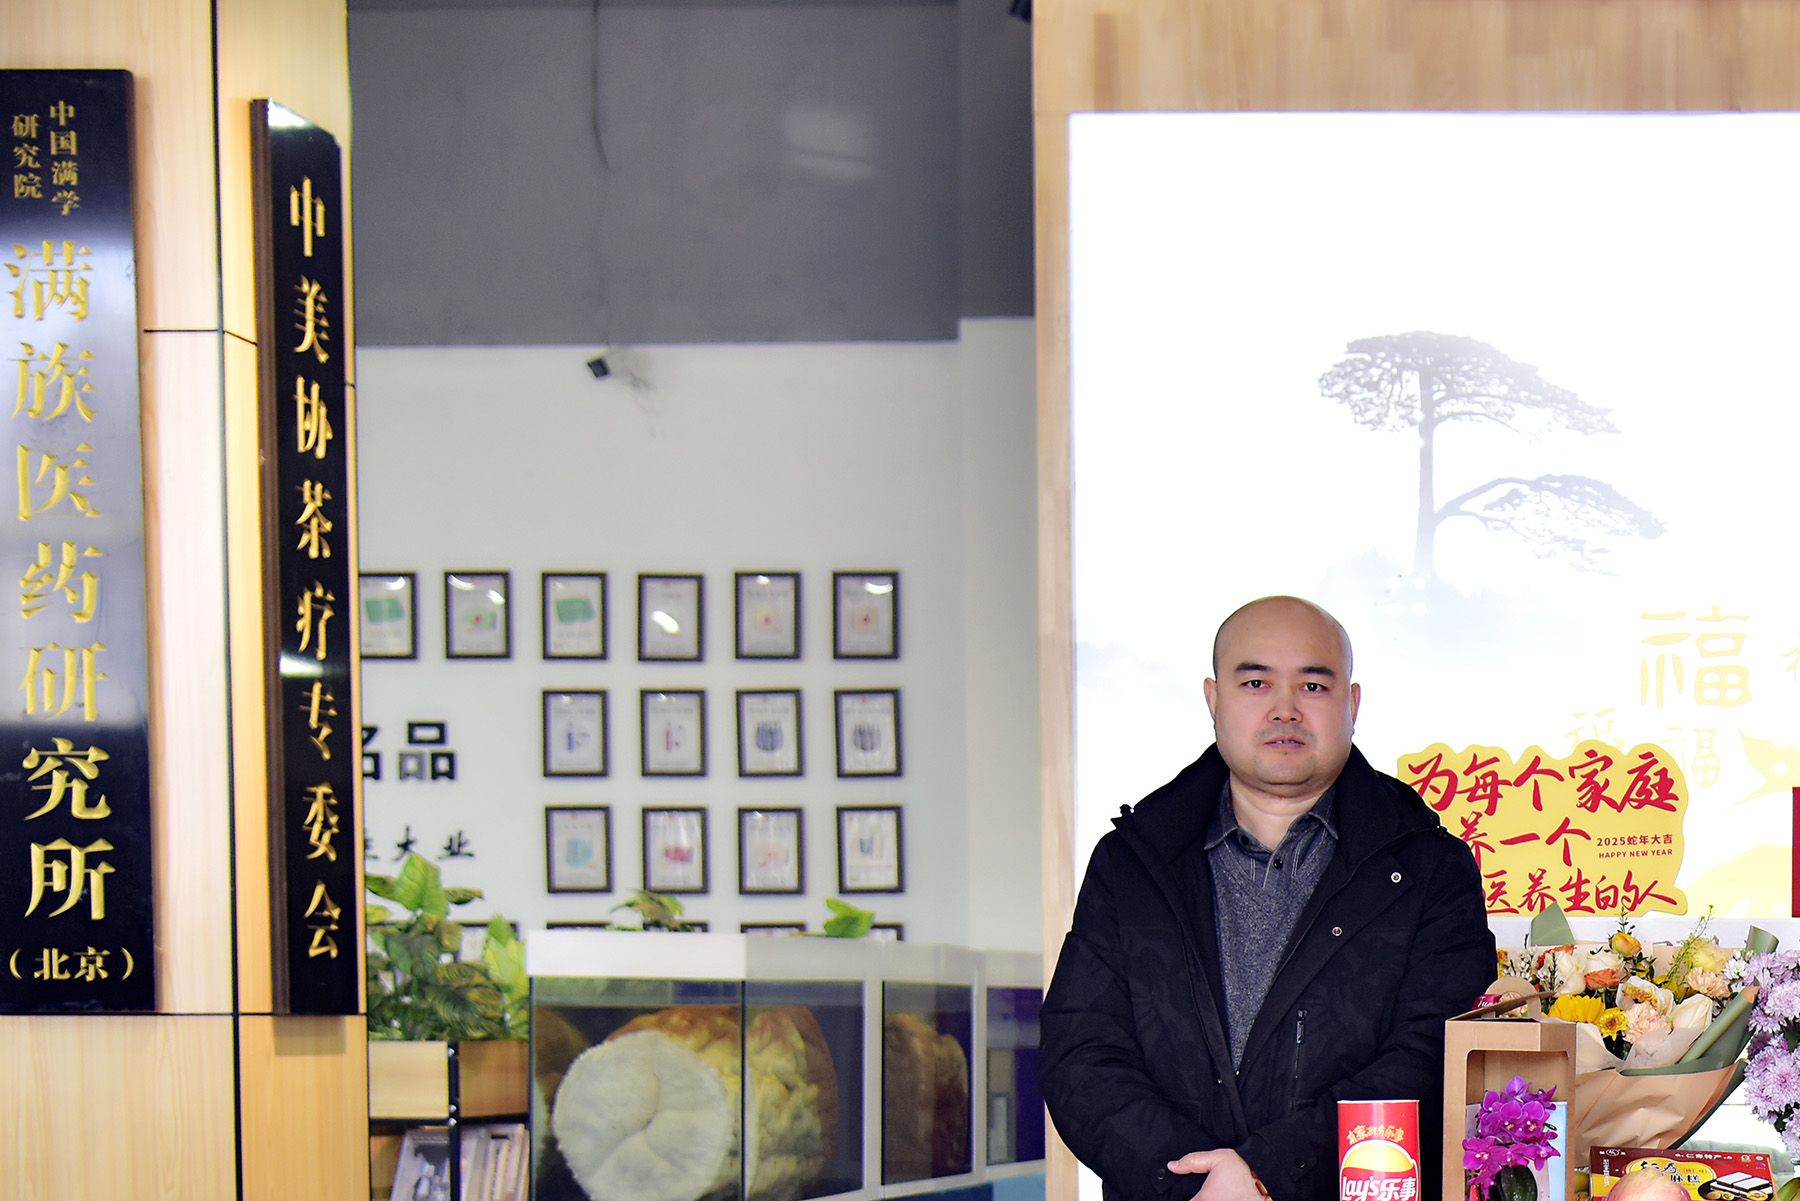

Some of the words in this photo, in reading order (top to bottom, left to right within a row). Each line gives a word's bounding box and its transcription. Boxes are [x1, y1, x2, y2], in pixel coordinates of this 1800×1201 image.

[11, 113, 43, 200] 研究院
[48, 100, 81, 216] 中国满学
[4, 239, 117, 921] 满族医药研究所
[289, 175, 342, 960] 中美协茶疗专委会
[1408, 749, 1680, 816] 为每个家庭
[1596, 833, 1674, 847] 2025蛇年大吉
[1598, 849, 1628, 860] HAPPY
[1629, 849, 1649, 858] NEW
[1650, 848, 1673, 858] YEAR
